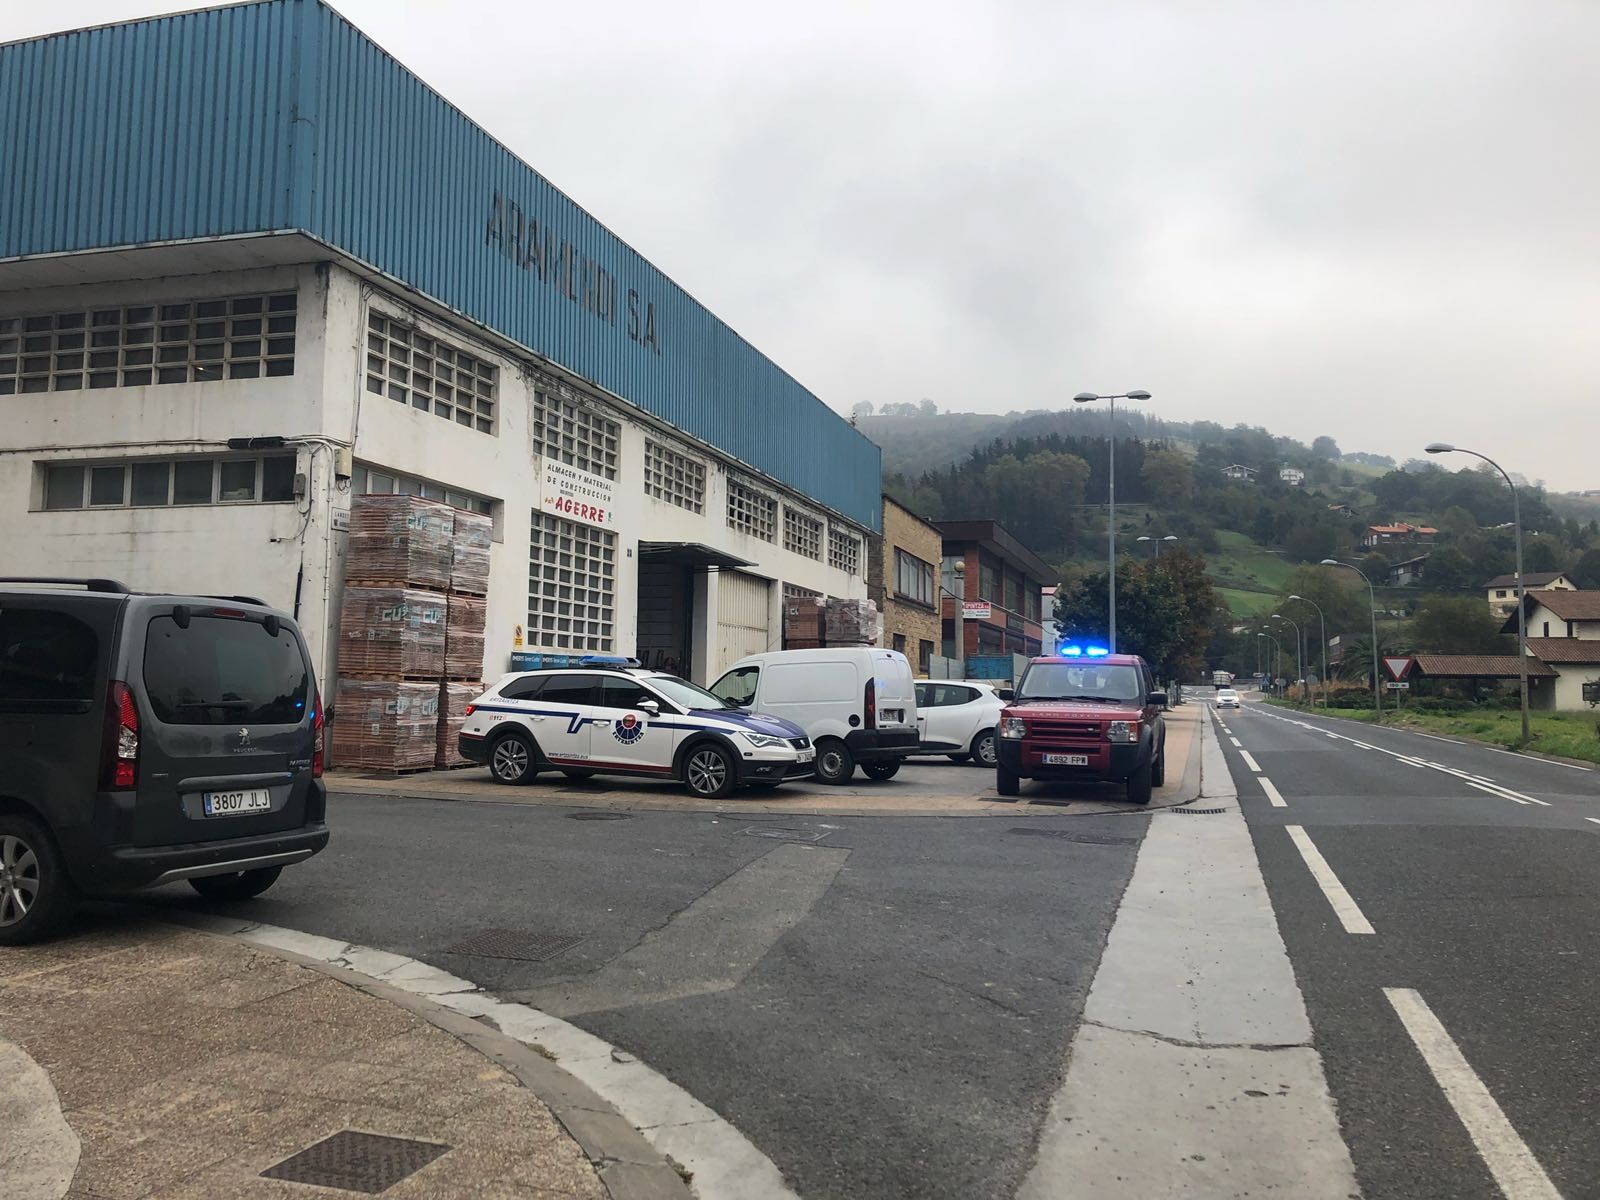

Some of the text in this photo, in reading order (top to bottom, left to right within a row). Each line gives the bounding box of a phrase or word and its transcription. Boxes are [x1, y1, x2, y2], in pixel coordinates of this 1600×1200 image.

[547, 464, 576, 479] ALMACEN
[584, 477, 612, 492] MATERIAL
[547, 475, 556, 485] DE
[560, 480, 611, 502] CONSTRUCCION
[555, 496, 605, 523] AGERRE
[1049, 755, 1086, 764] 4892 FPW
[213, 791, 267, 811] 3807 JLJ
